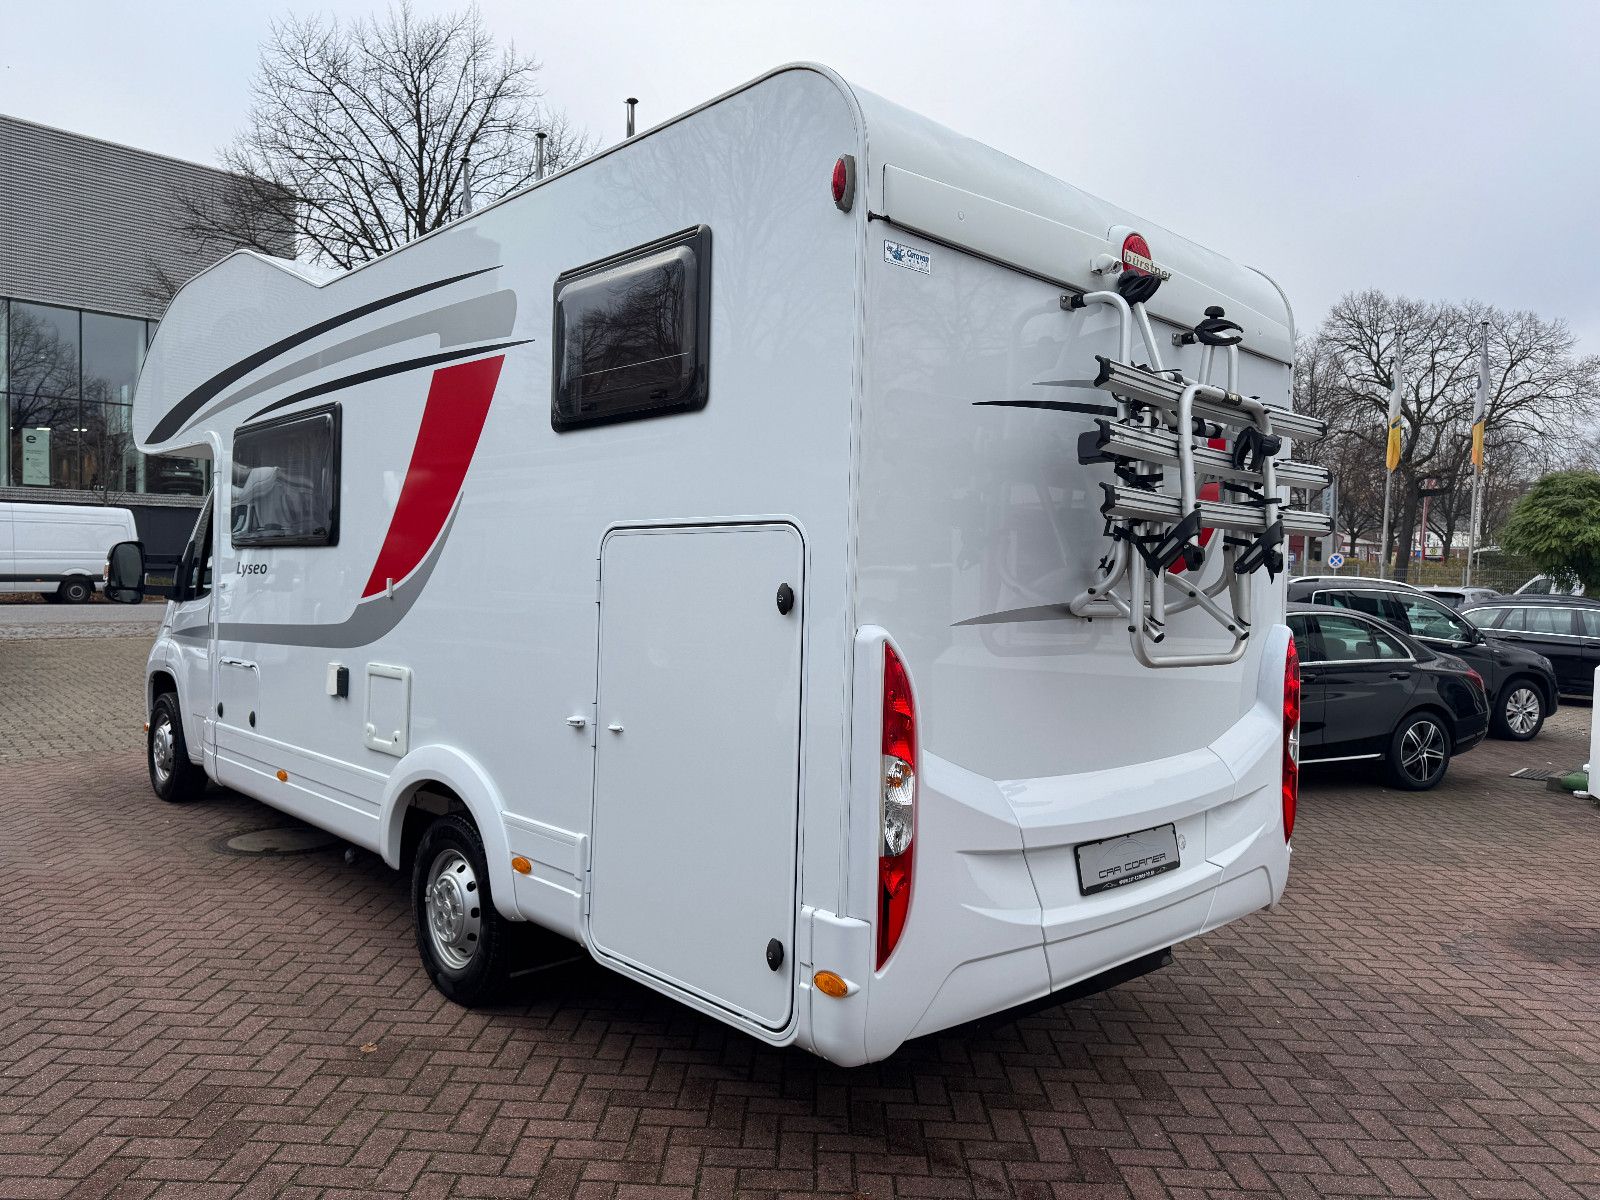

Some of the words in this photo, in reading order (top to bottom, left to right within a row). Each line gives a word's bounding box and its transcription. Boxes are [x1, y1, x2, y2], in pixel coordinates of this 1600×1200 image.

[1124, 250, 1172, 280] bürstner
[236, 561, 268, 578] Lyseo
[1098, 865, 1122, 879] CAR
[1124, 852, 1167, 872] CORNER
